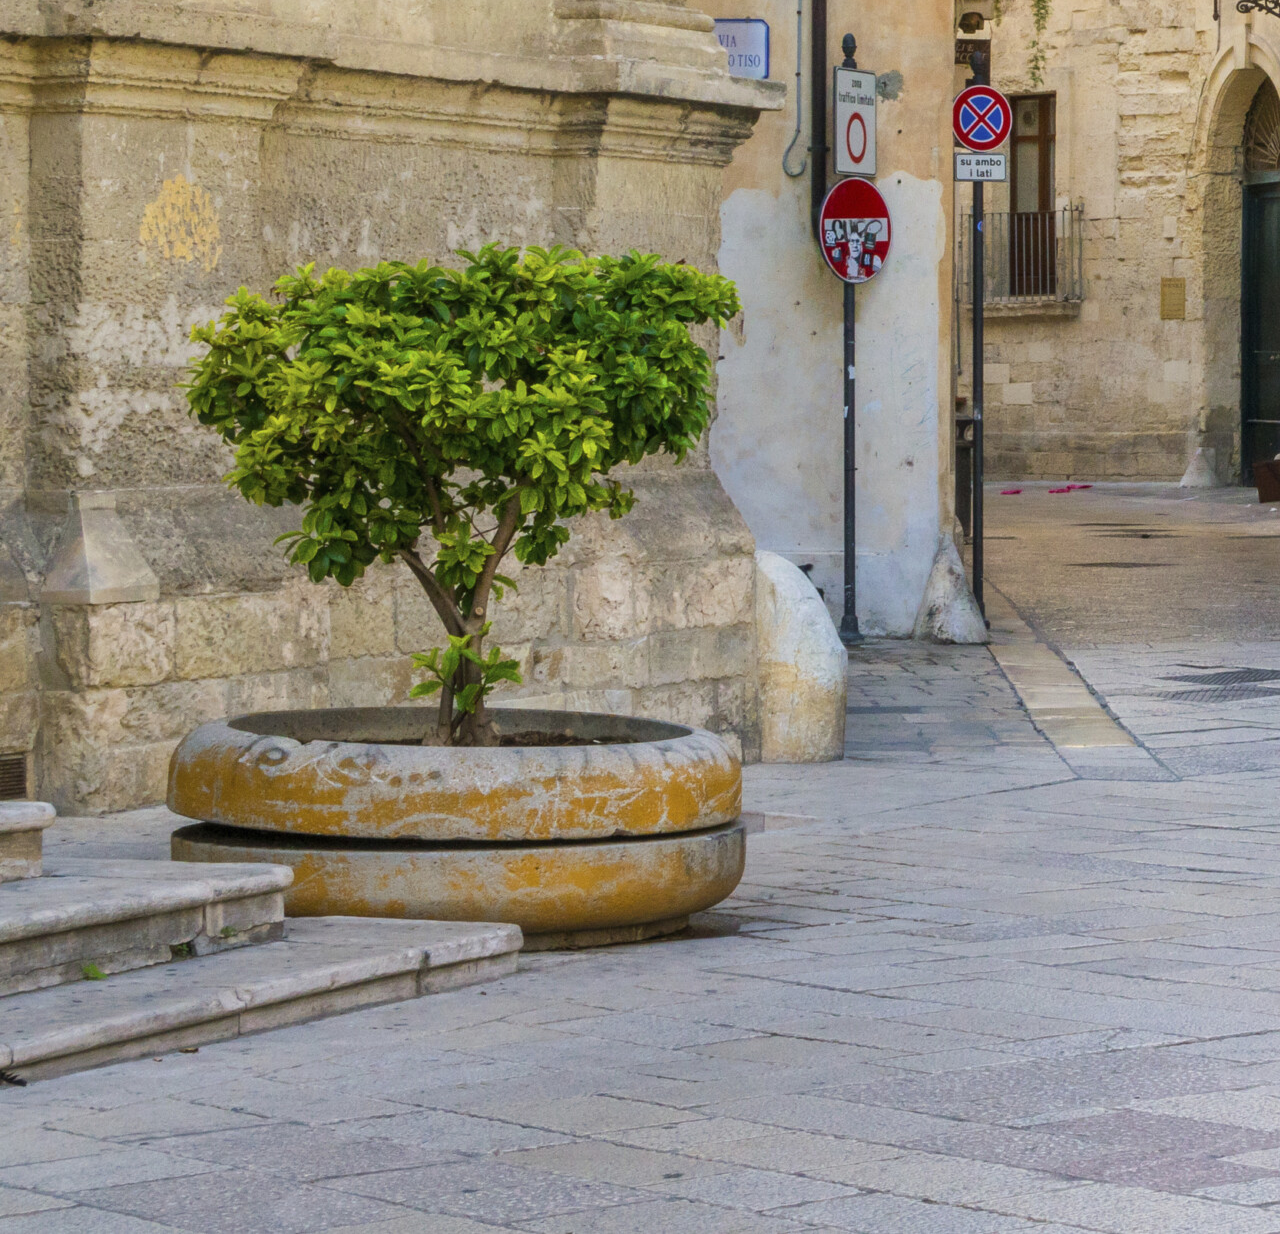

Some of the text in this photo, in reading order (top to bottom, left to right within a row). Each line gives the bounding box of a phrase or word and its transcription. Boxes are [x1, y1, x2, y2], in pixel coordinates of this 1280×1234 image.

[718, 34, 737, 47] VIA
[737, 54, 761, 68] TISO
[851, 79, 862, 89] zona
[838, 91, 875, 106] traffico limitato
[960, 157, 1002, 167] su ambo
[976, 168, 993, 178] lati
